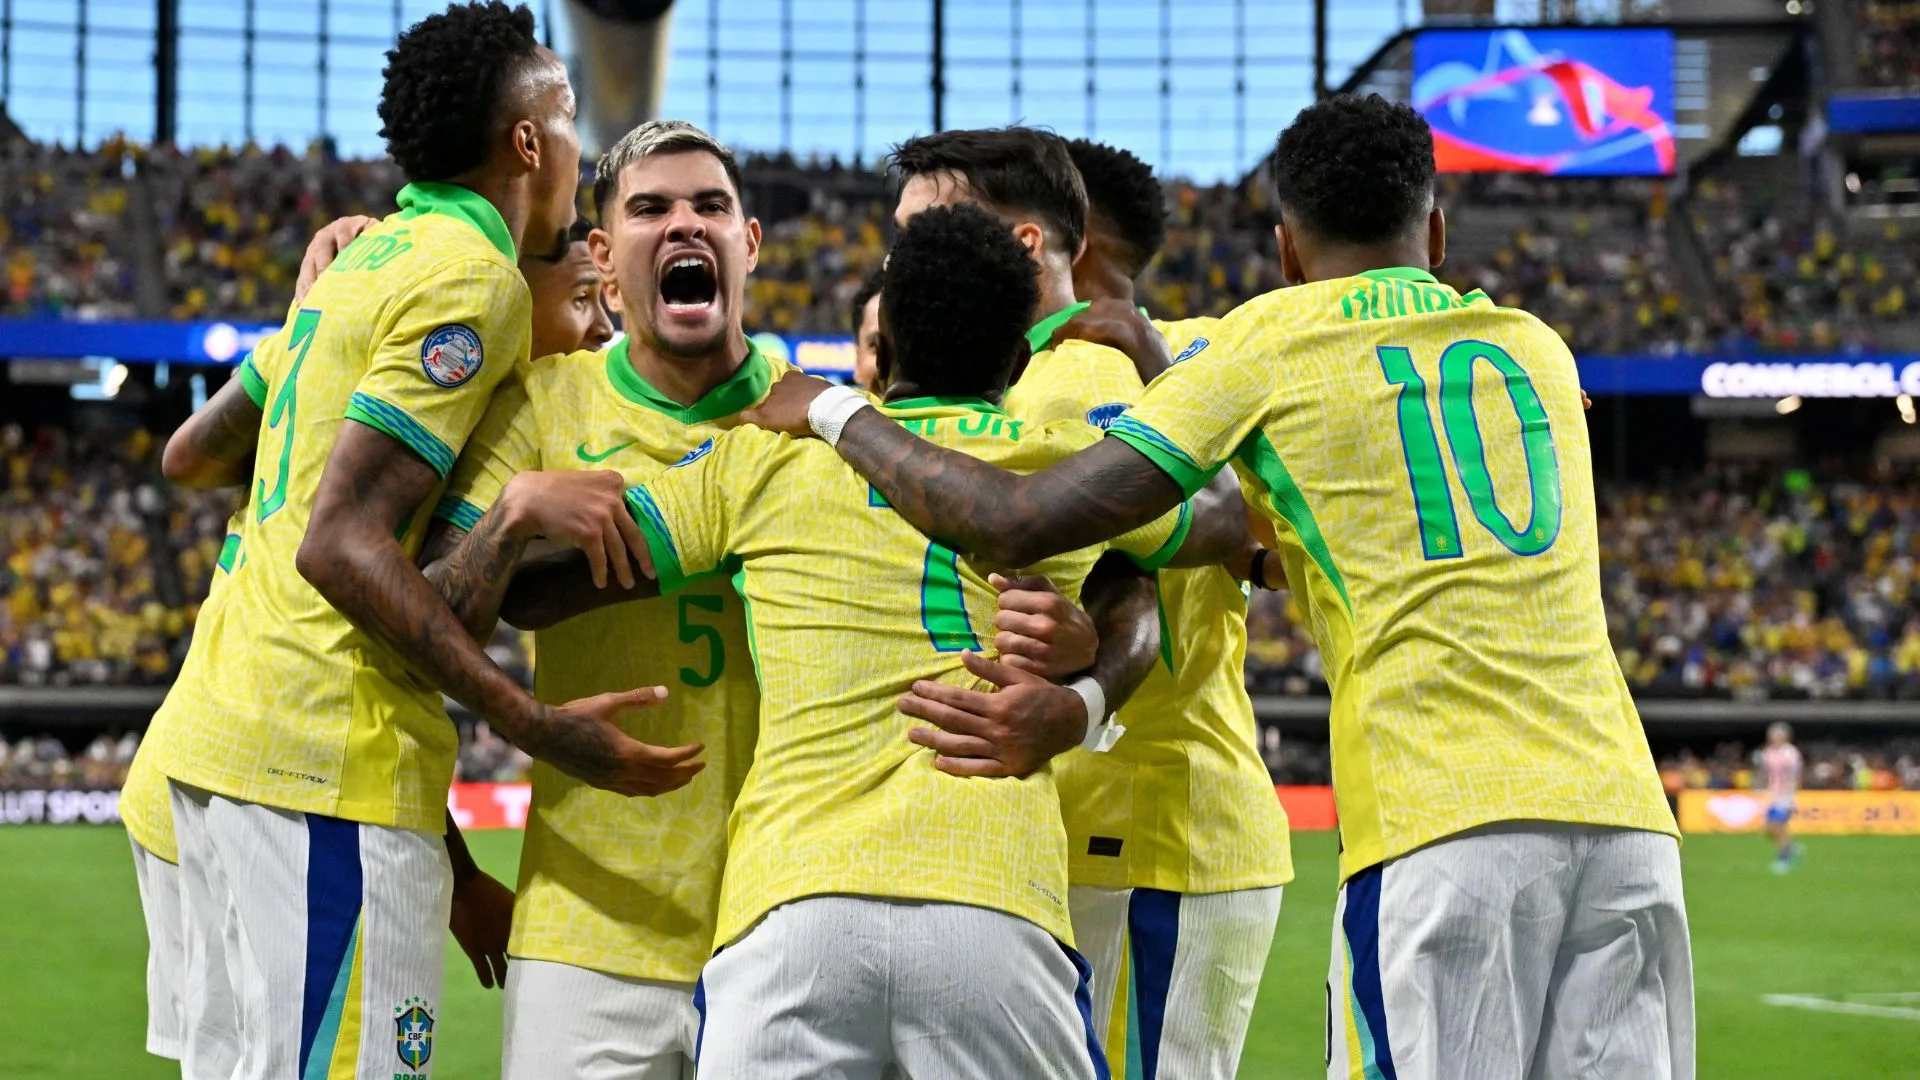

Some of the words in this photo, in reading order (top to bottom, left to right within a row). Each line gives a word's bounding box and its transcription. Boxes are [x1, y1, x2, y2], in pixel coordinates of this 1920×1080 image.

[257, 309, 321, 524] 3
[1376, 339, 1562, 560] 10
[678, 595, 725, 687] 5
[408, 1032, 423, 1041] CBF
